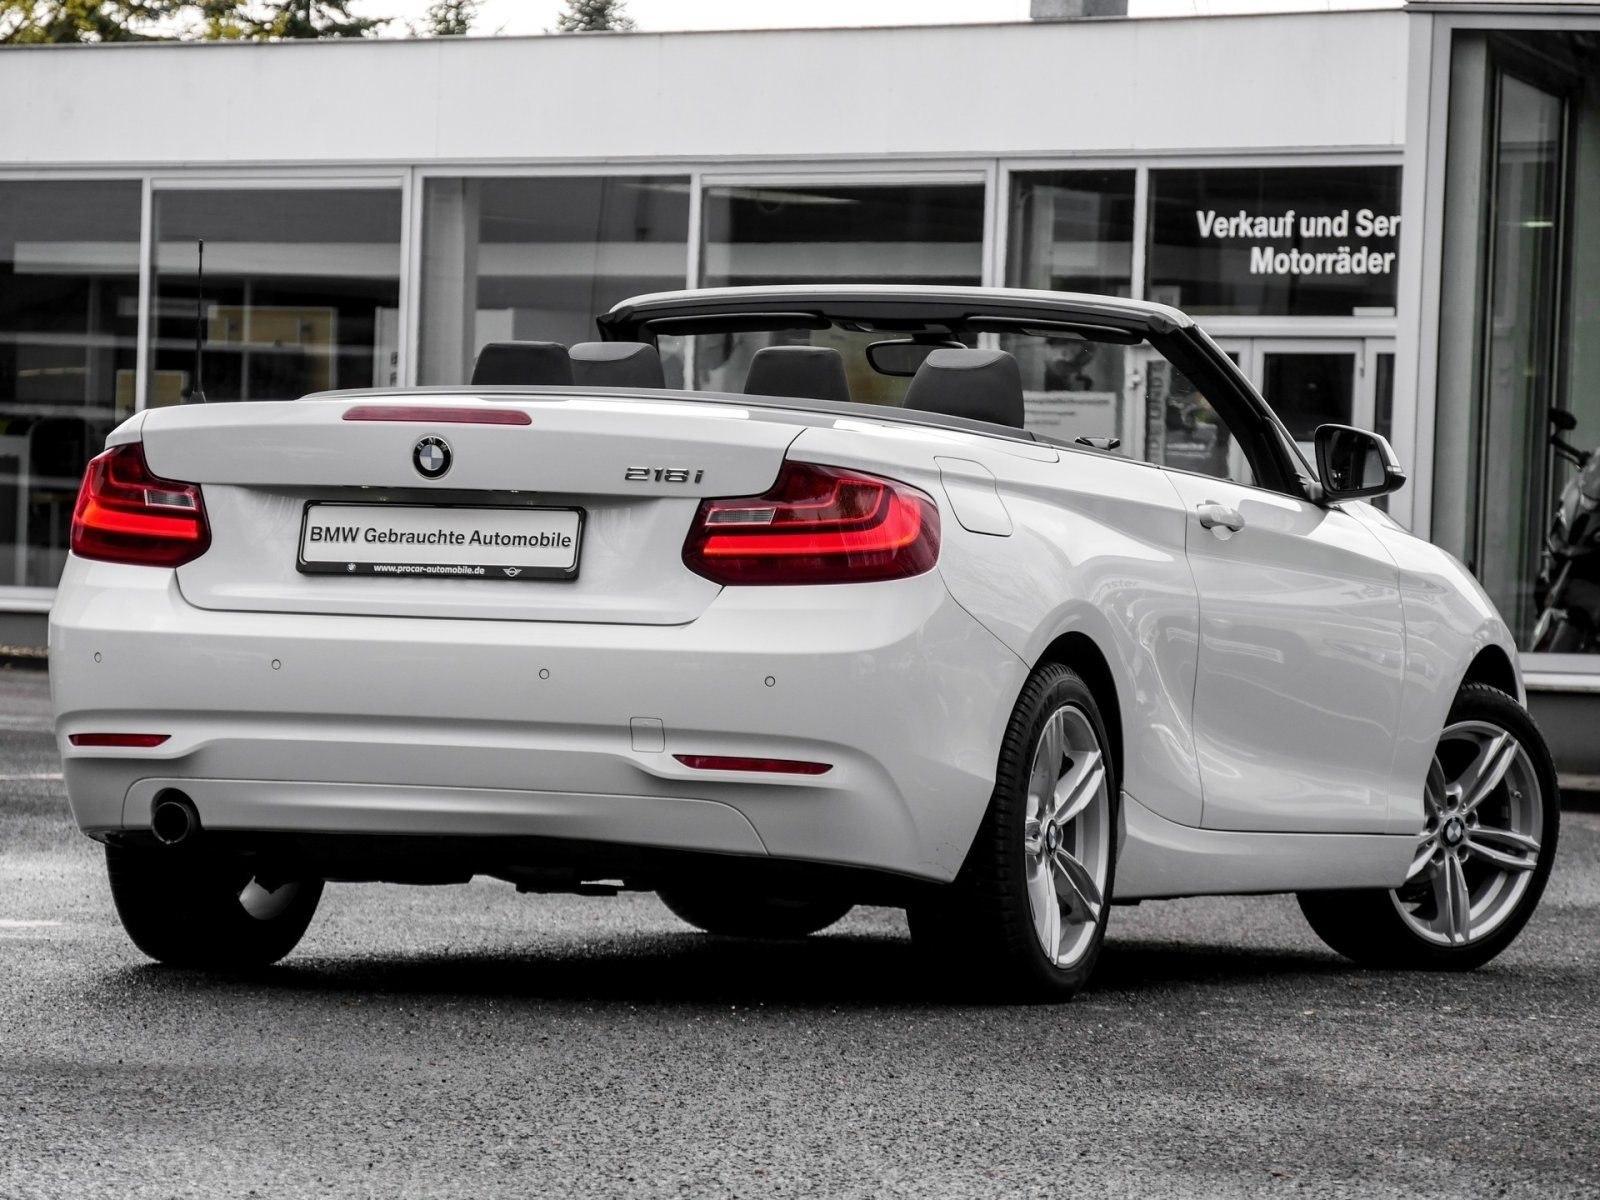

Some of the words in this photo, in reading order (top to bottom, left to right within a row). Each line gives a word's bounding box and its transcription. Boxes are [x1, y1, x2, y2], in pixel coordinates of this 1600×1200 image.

[1196, 209, 1296, 238] Verkauf
[1300, 209, 1349, 238] und
[1355, 208, 1401, 238] Ser
[1250, 246, 1395, 275] Motorräder
[310, 526, 360, 542] BMW
[364, 527, 465, 545] Gebrauchte
[469, 530, 572, 547] Automobile
[373, 564, 486, 575] www.procar-automobile.de
